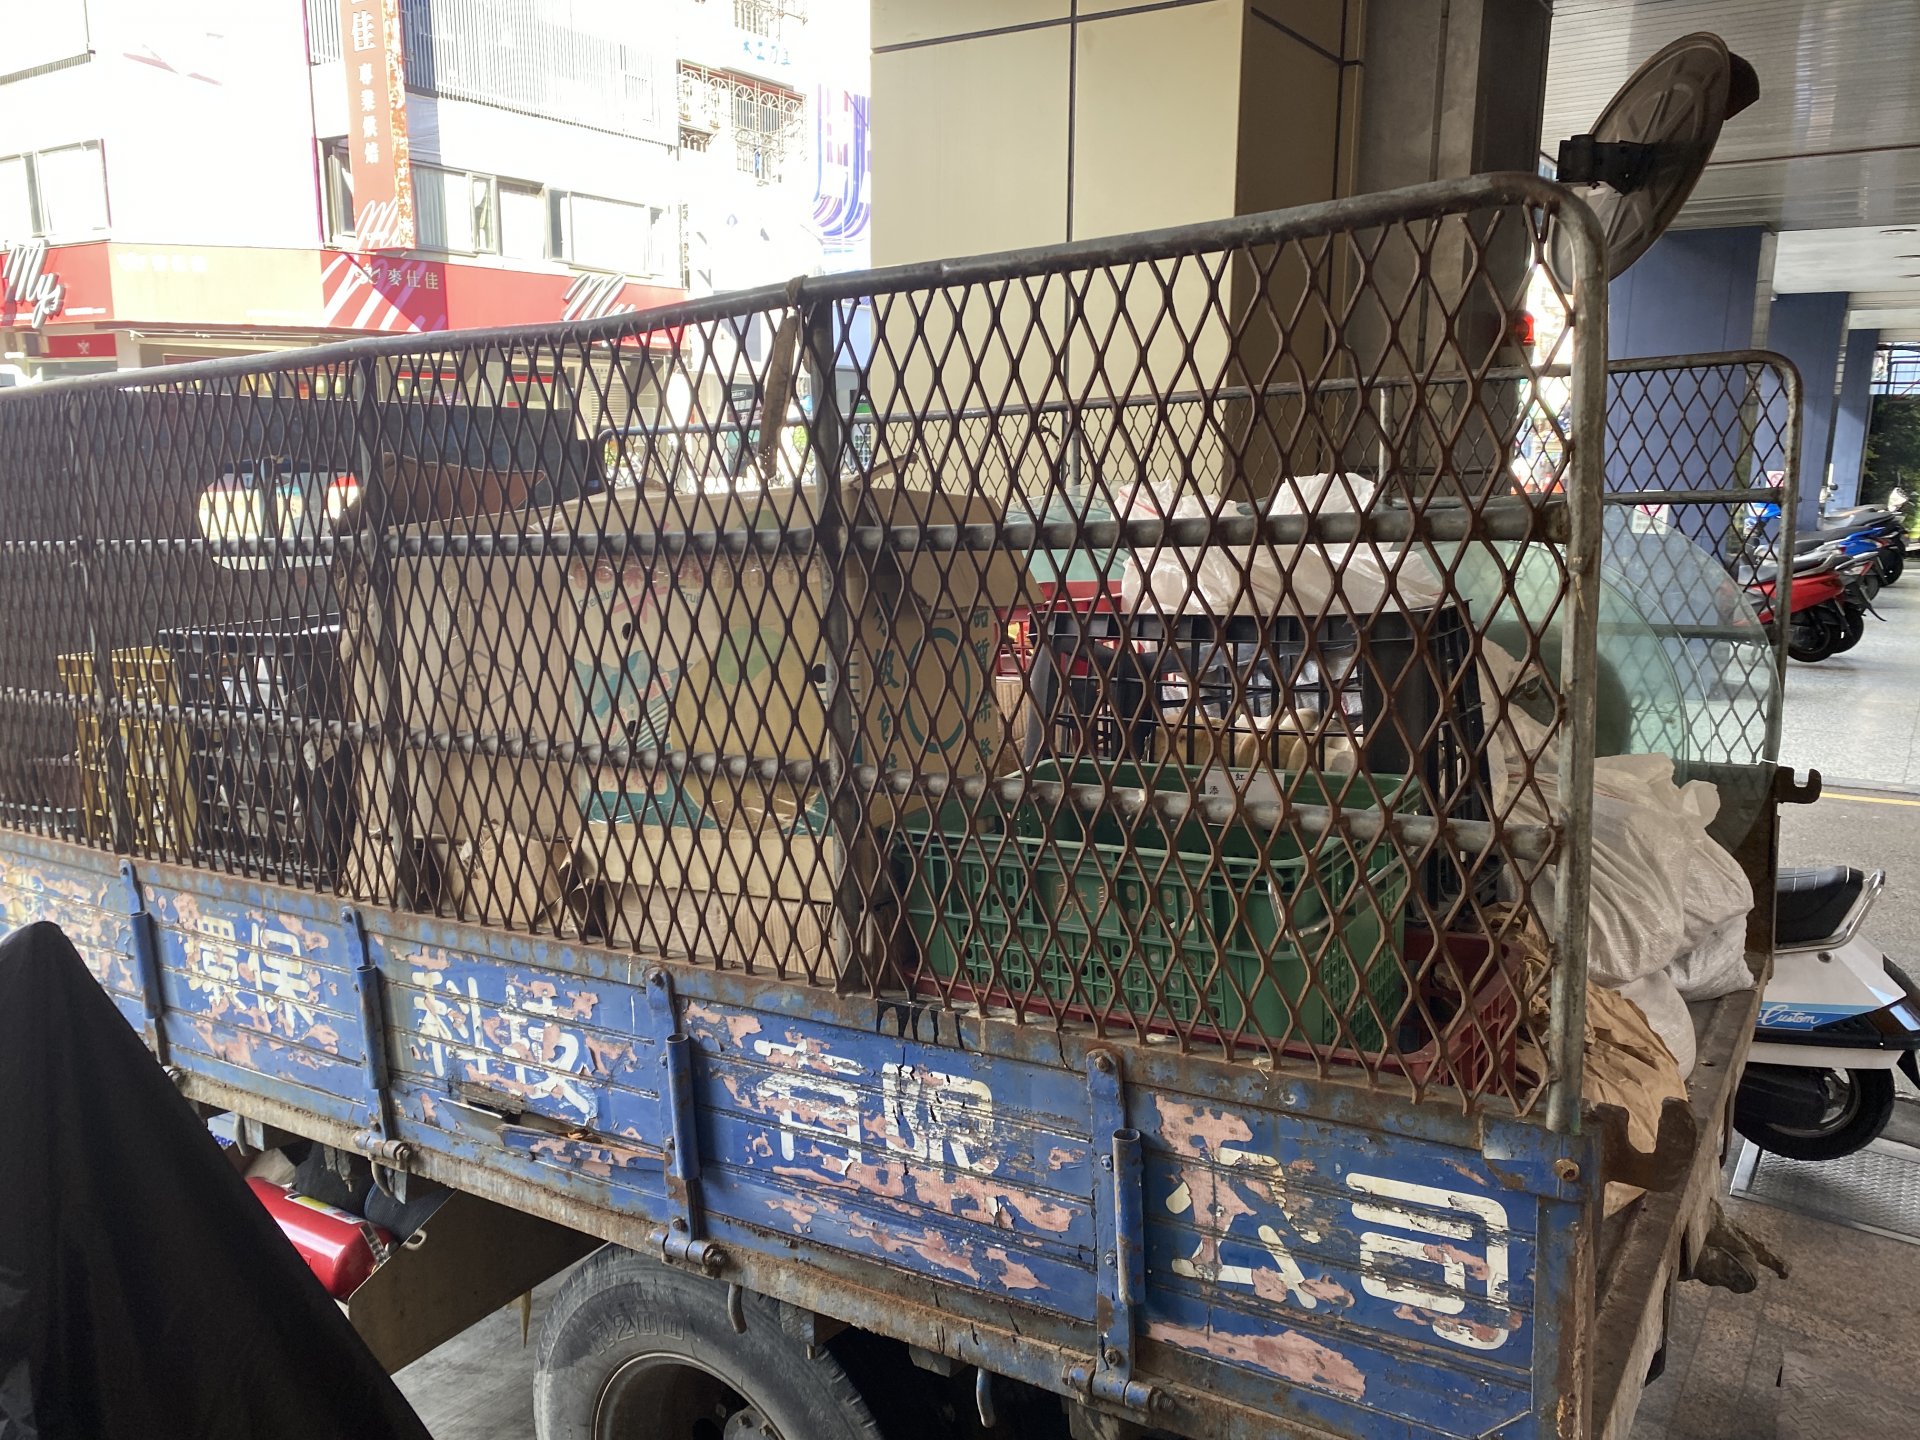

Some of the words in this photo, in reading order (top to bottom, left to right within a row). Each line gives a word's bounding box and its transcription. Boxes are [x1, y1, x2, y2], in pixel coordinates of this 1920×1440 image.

[387, 268, 439, 290] 麥仕佳
[1761, 1004, 1823, 1026] Custom
[412, 971, 591, 1114] 科技
[754, 1039, 999, 1177] 有限
